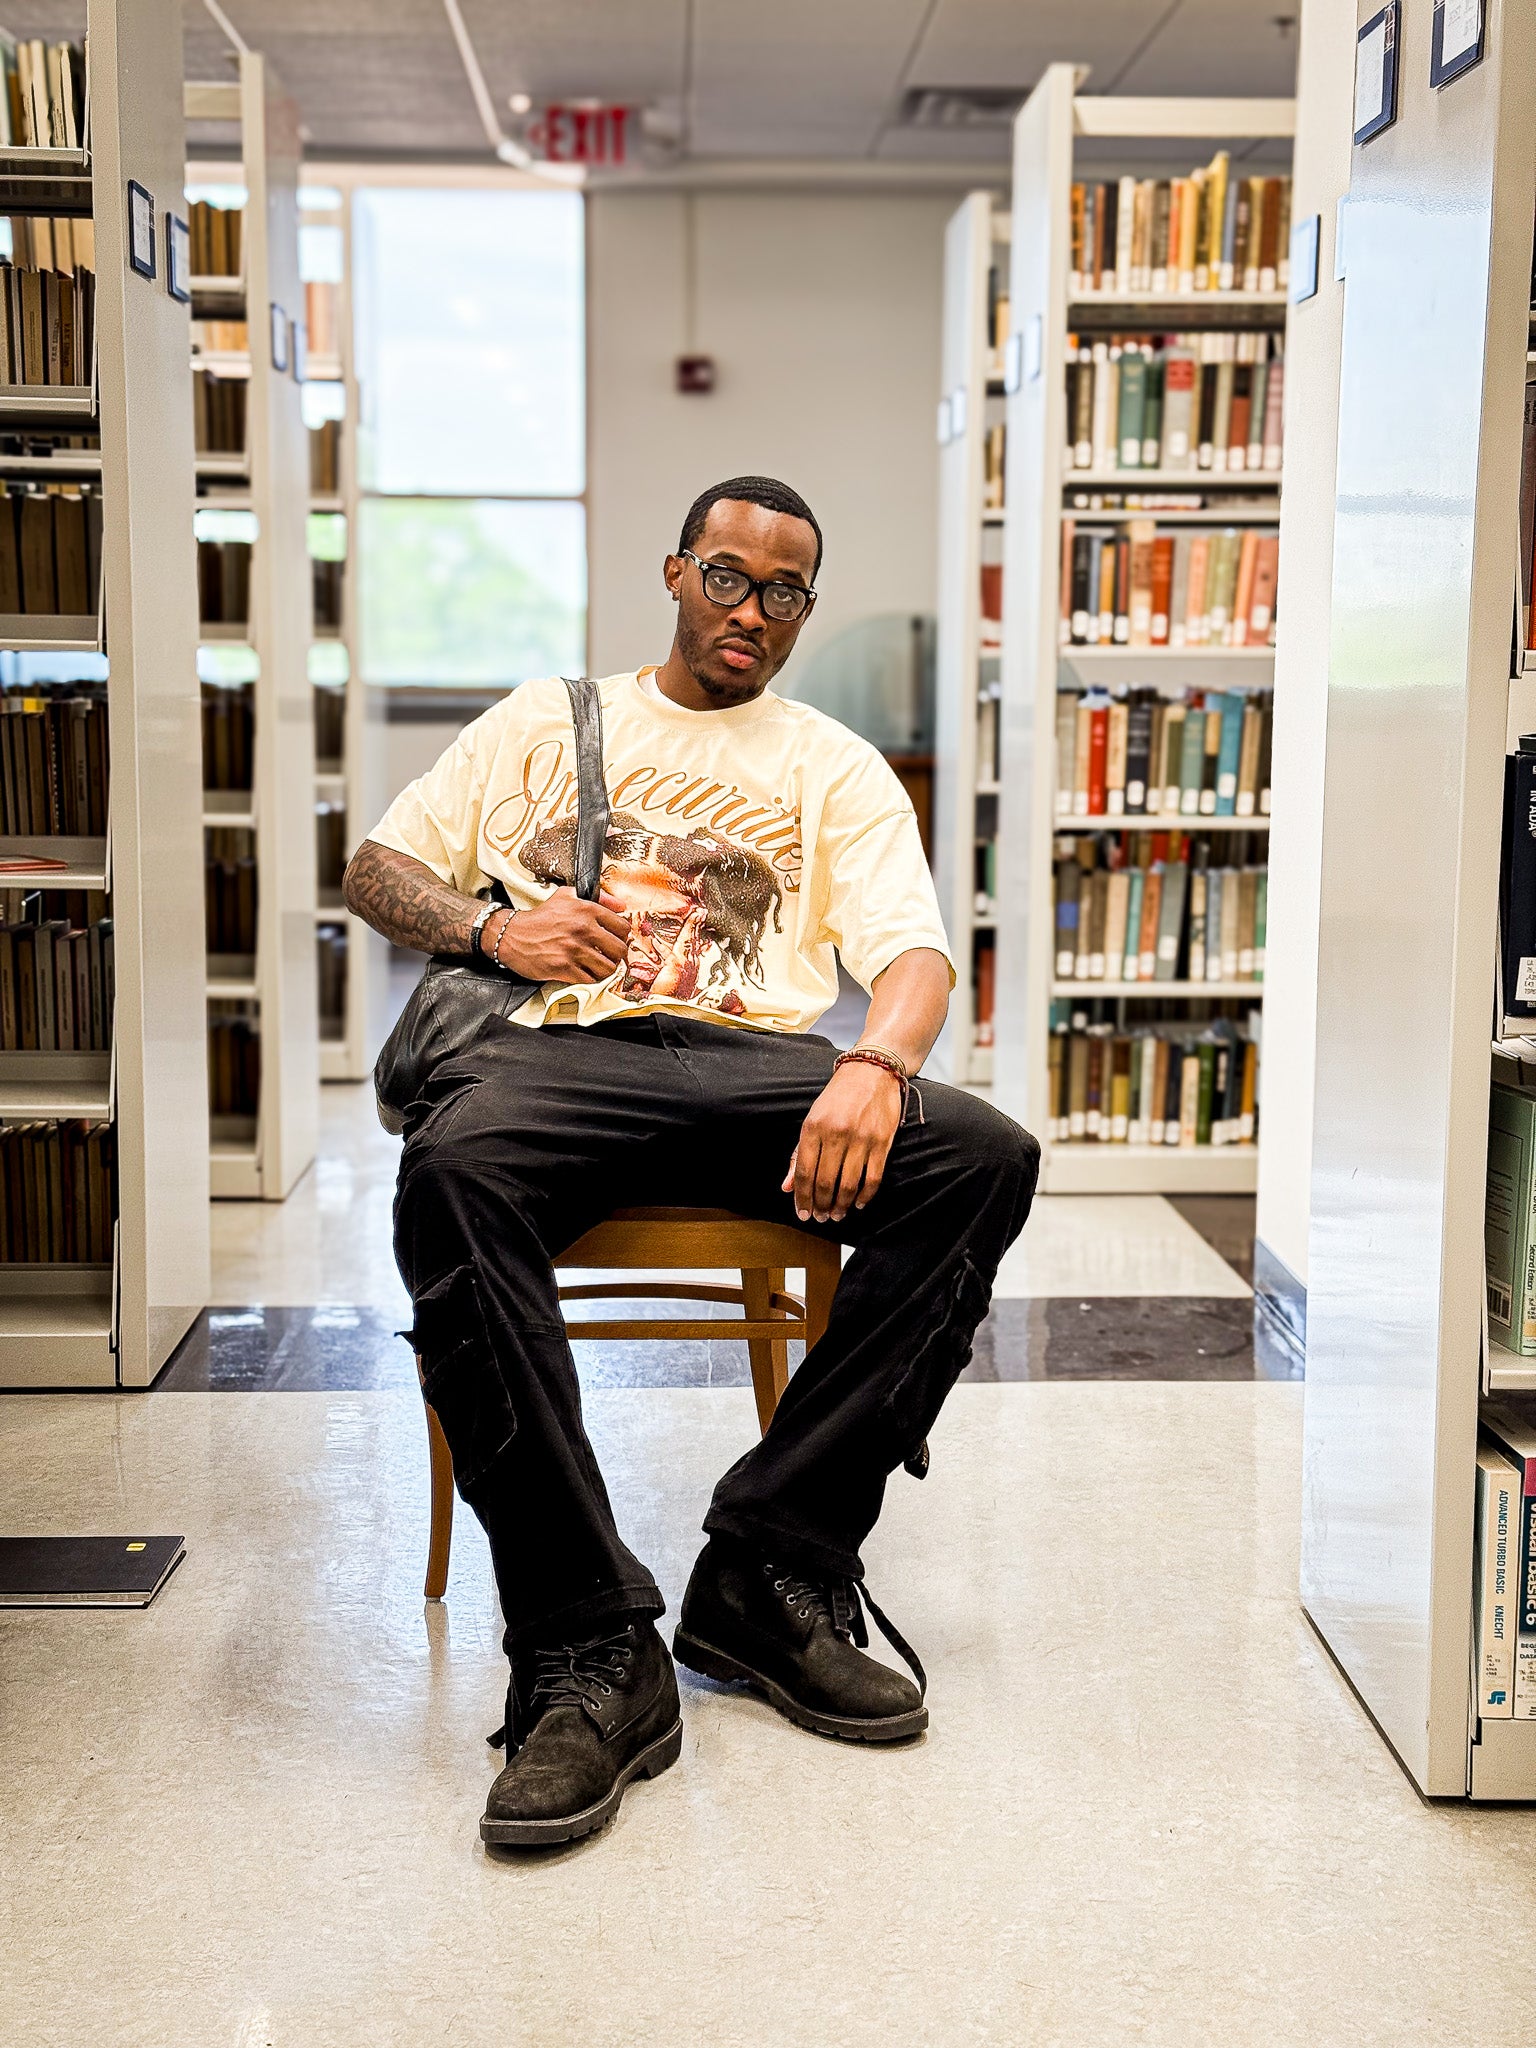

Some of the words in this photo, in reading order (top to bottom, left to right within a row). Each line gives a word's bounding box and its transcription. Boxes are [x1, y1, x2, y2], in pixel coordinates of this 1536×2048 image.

[546, 105, 628, 164] EXIT
[484, 740, 803, 892] Inecuritie
[1528, 1244, 1536, 1267] Second
[1527, 1269, 1536, 1291] Edition
[1498, 1490, 1508, 1535] ADVANCED
[1497, 1537, 1507, 1566] TURBO
[1495, 1568, 1506, 1595] BASIC
[1494, 1605, 1505, 1639] KNECHT
[1526, 1613, 1536, 1625] 6
